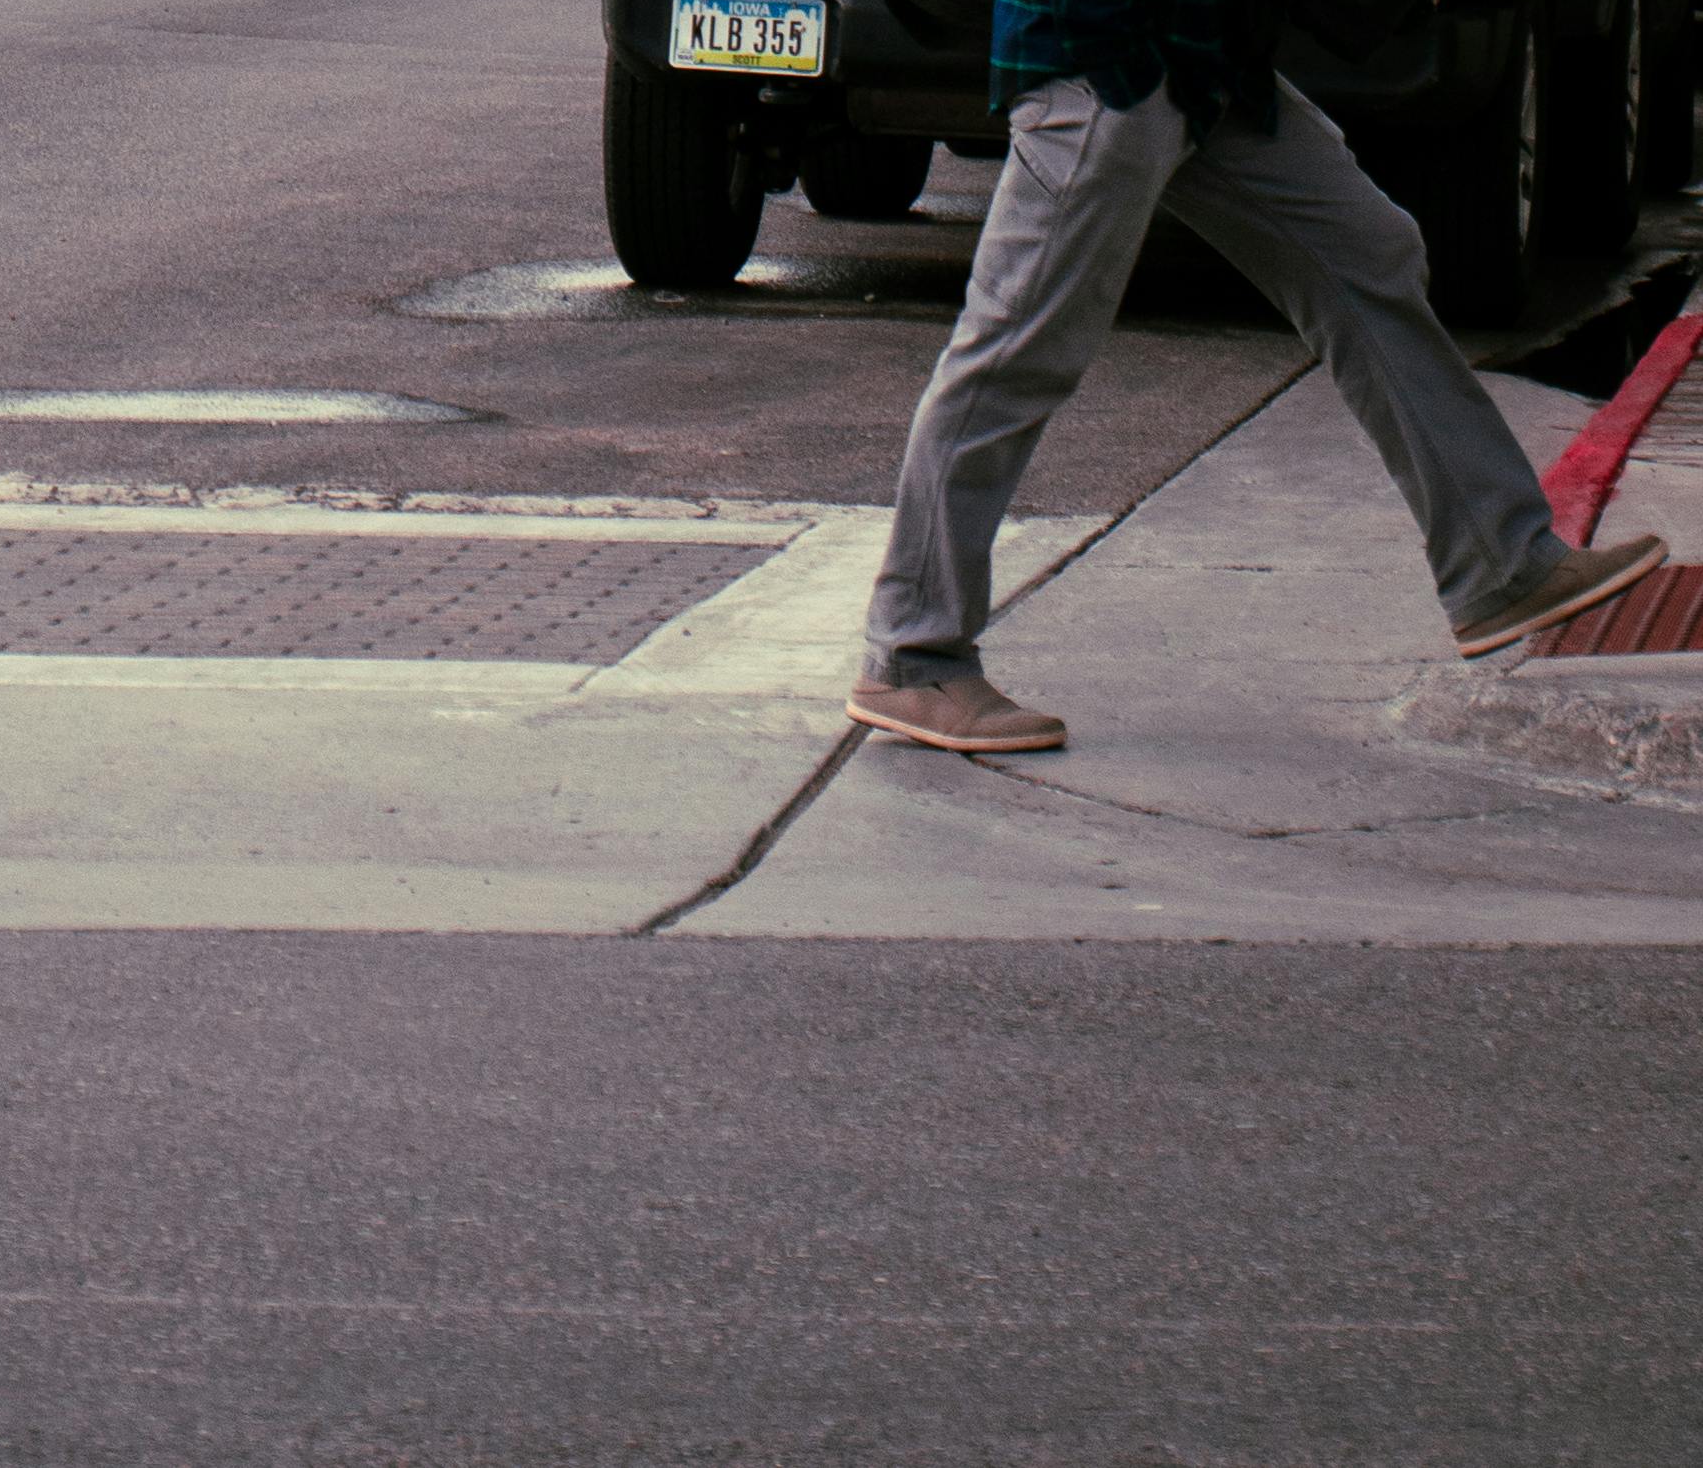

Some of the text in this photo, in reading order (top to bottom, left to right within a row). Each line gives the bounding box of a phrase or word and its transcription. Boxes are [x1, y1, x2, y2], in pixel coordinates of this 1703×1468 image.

[728, 1, 772, 17] IOWA
[690, 14, 803, 57] KLB 355
[731, 54, 762, 66] SCOTT
